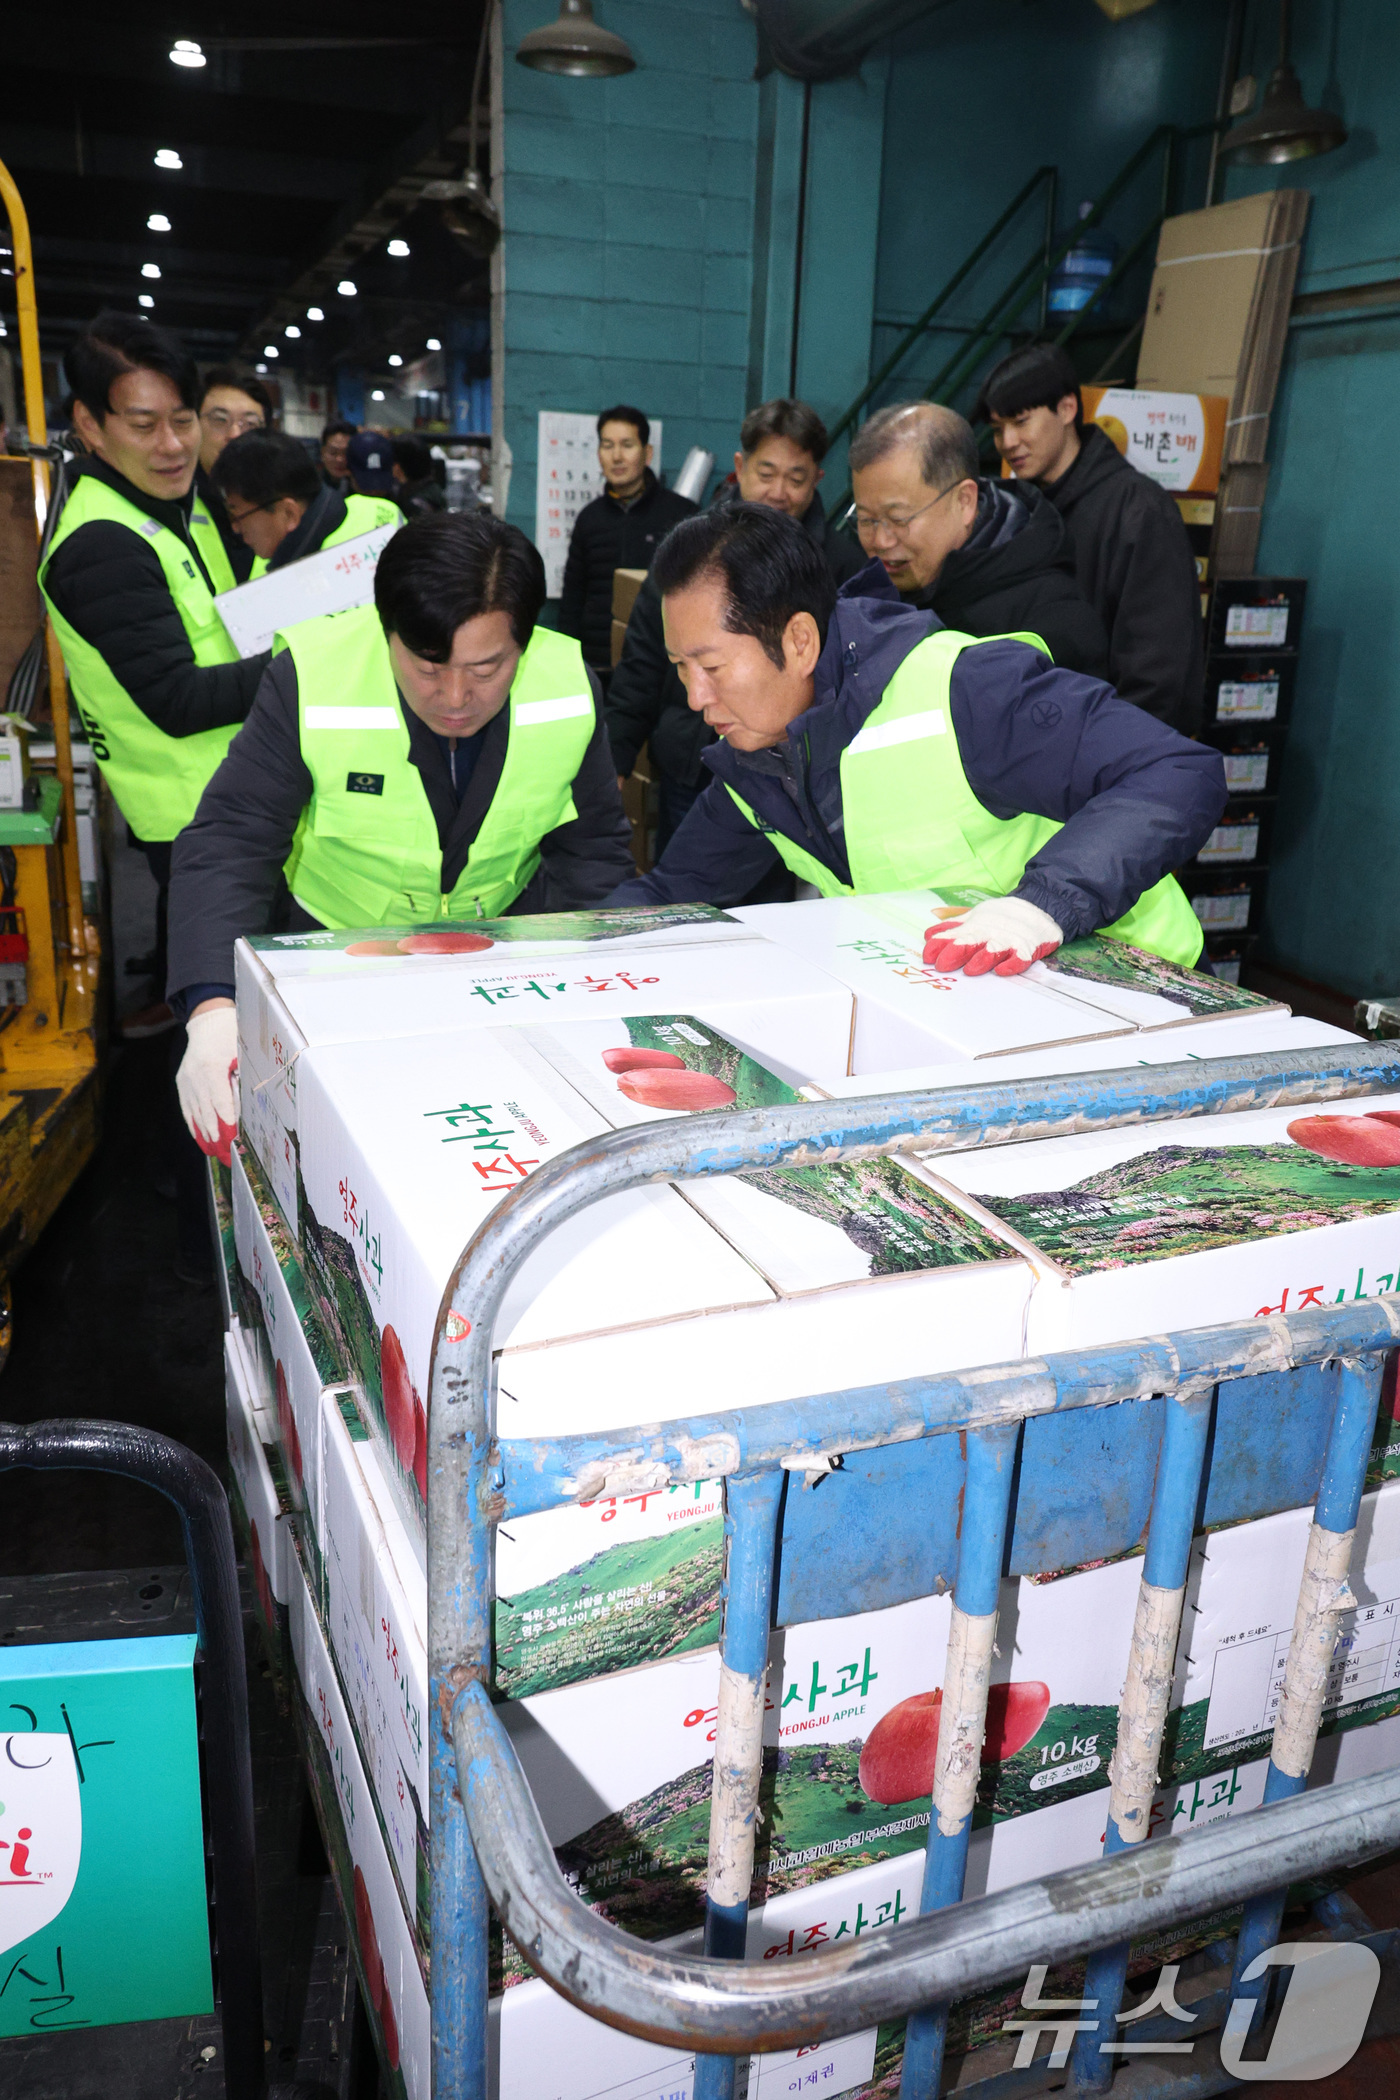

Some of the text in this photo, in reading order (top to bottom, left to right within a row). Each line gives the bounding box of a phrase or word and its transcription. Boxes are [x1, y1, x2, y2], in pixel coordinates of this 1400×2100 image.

[470, 971, 660, 1005] 영주사과
[339, 1176, 383, 1286] 영주사과
[667, 1502, 715, 1522] YEONGJU
[572, 1592, 603, 1611] 사람을
[606, 1585, 636, 1602] 살리는
[521, 1622, 543, 1638] 영주
[590, 1605, 611, 1620] 주는
[614, 1594, 644, 1613] 자연의
[1365, 1603, 1394, 1621] 표 시
[1238, 1632, 1245, 1641] 후
[1338, 1657, 1359, 1671] 영주시
[381, 1617, 423, 1754] 영주사과
[1343, 1672, 1358, 1685] 보통
[778, 1704, 867, 1737] YEONGJU APPLE
[1041, 1734, 1100, 1765] 10 kg
[1037, 1759, 1094, 1786] 영주 소백산
[585, 1858, 622, 1878] 살리는
[594, 1868, 632, 1888] 자연의
[788, 2062, 835, 2092] 이재권
